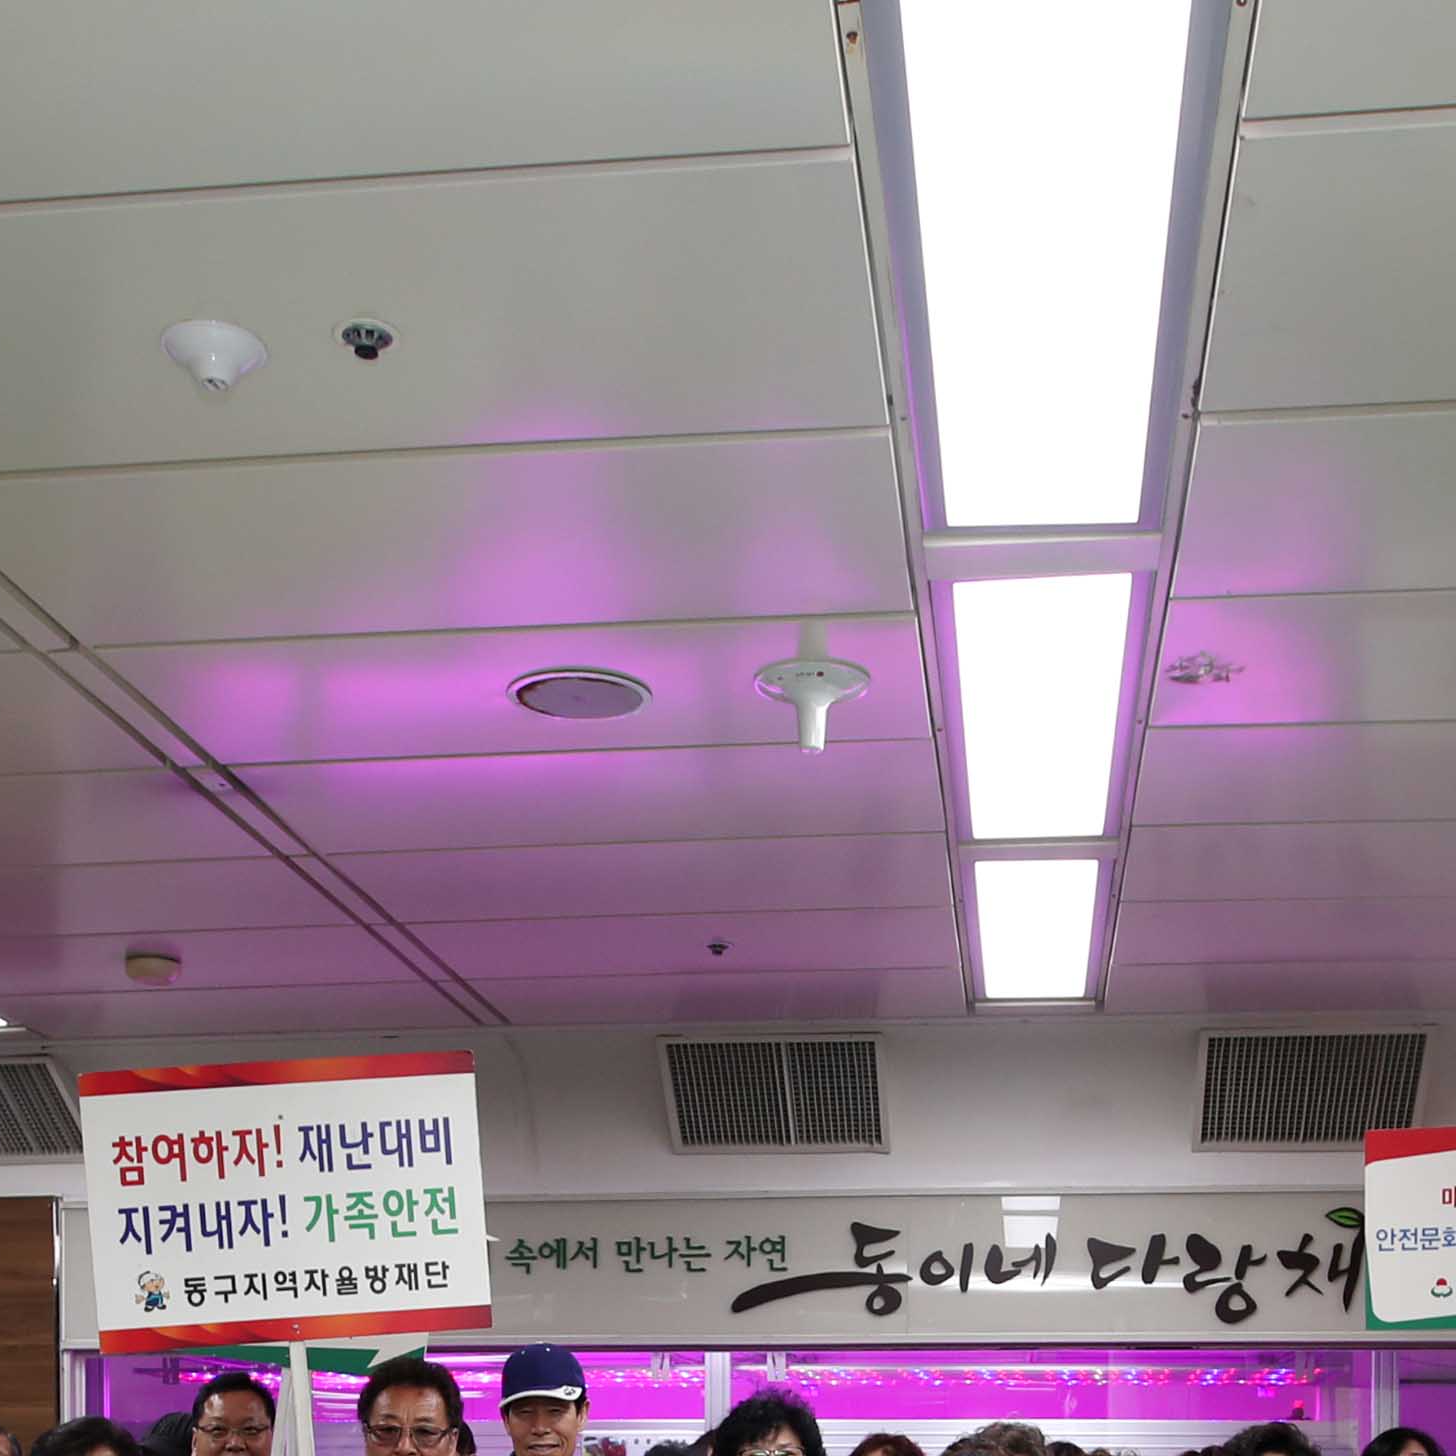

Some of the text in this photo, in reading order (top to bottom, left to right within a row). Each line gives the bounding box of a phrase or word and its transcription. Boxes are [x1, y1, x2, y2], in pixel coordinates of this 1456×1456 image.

[112, 1117, 453, 1187] 참여하자! 재난대비
[118, 1186, 459, 1255] 지켜내자! 가족안전
[505, 1235, 788, 1274] 속에서 만나는 자연
[183, 1261, 450, 1307] 동구지역자율방재단
[731, 1207, 1365, 1324] 동이네 다랑채
